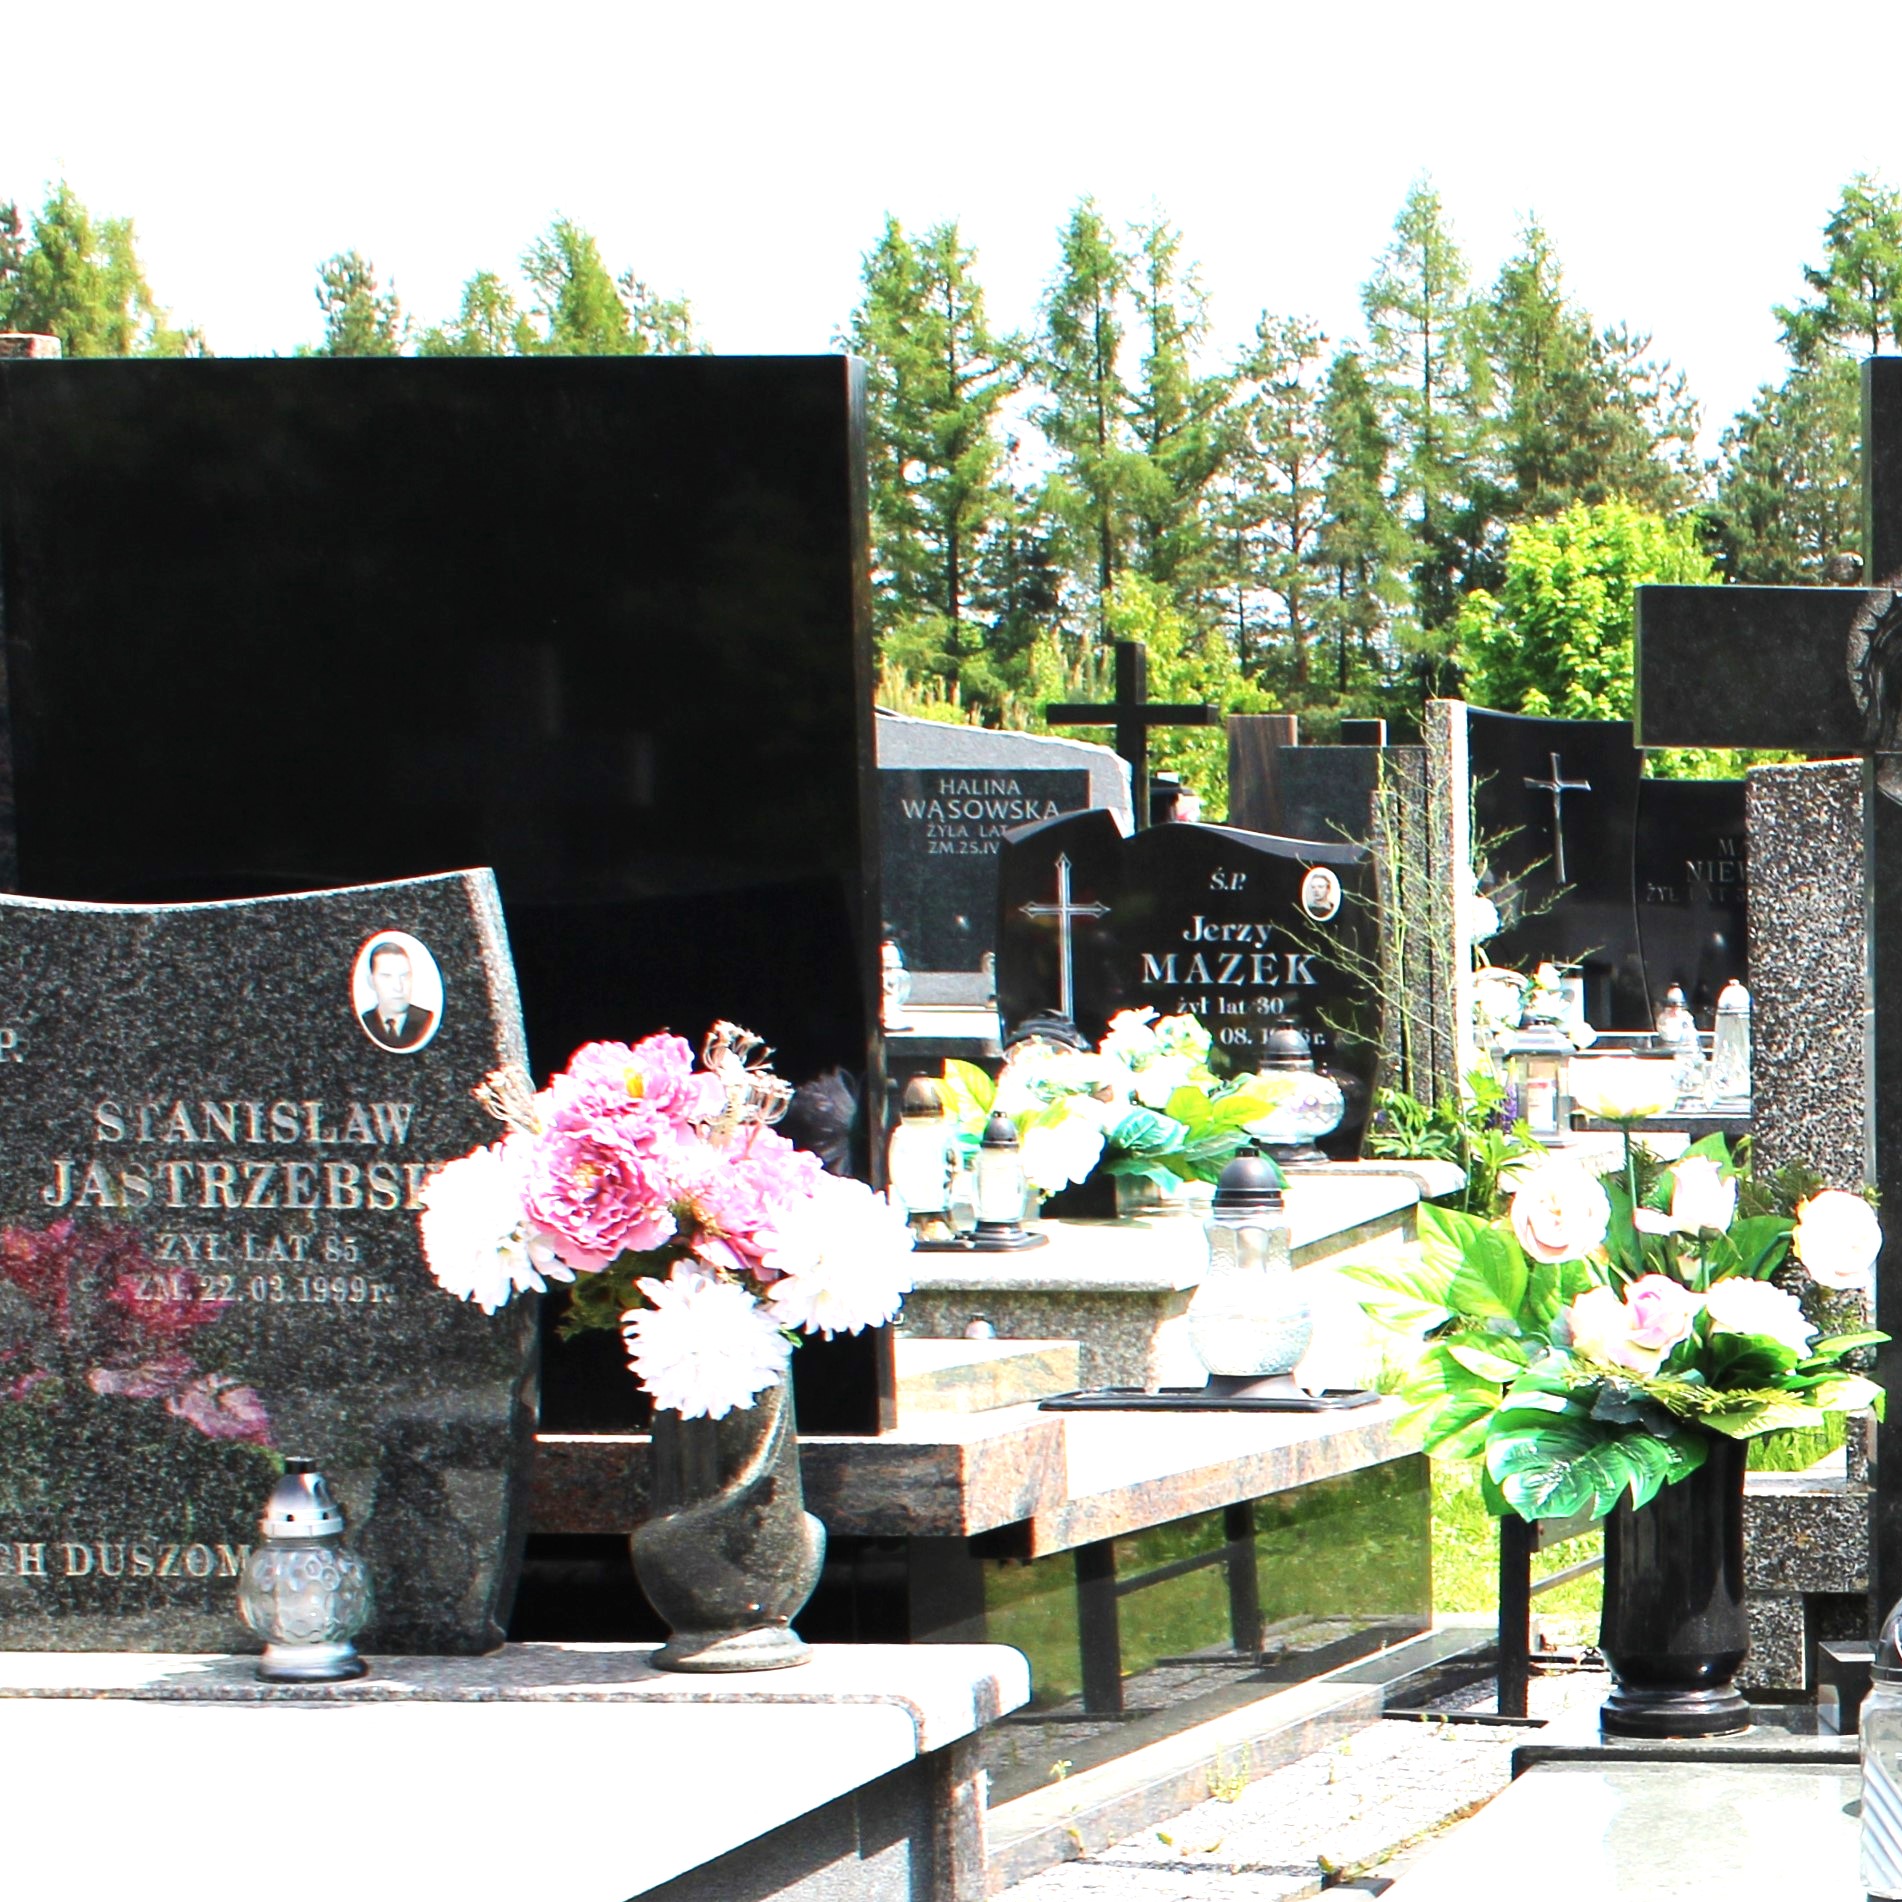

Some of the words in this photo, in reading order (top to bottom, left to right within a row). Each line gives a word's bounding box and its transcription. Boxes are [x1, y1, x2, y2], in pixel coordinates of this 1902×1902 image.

[939, 778, 1022, 796] HALINA
[902, 799, 1060, 823] WĄSOWSKA
[1209, 867, 1246, 891] Ś.P.
[1182, 915, 1272, 949] Jerzy
[1141, 952, 1318, 987] MAZEK
[1218, 996, 1246, 1015] lat
[1257, 996, 1285, 1015] 30
[1219, 1027, 1253, 1045] 08.
[244, 1232, 310, 1262] LAT
[324, 1233, 361, 1263] 85
[62, 1542, 250, 1577] DUSZOM
